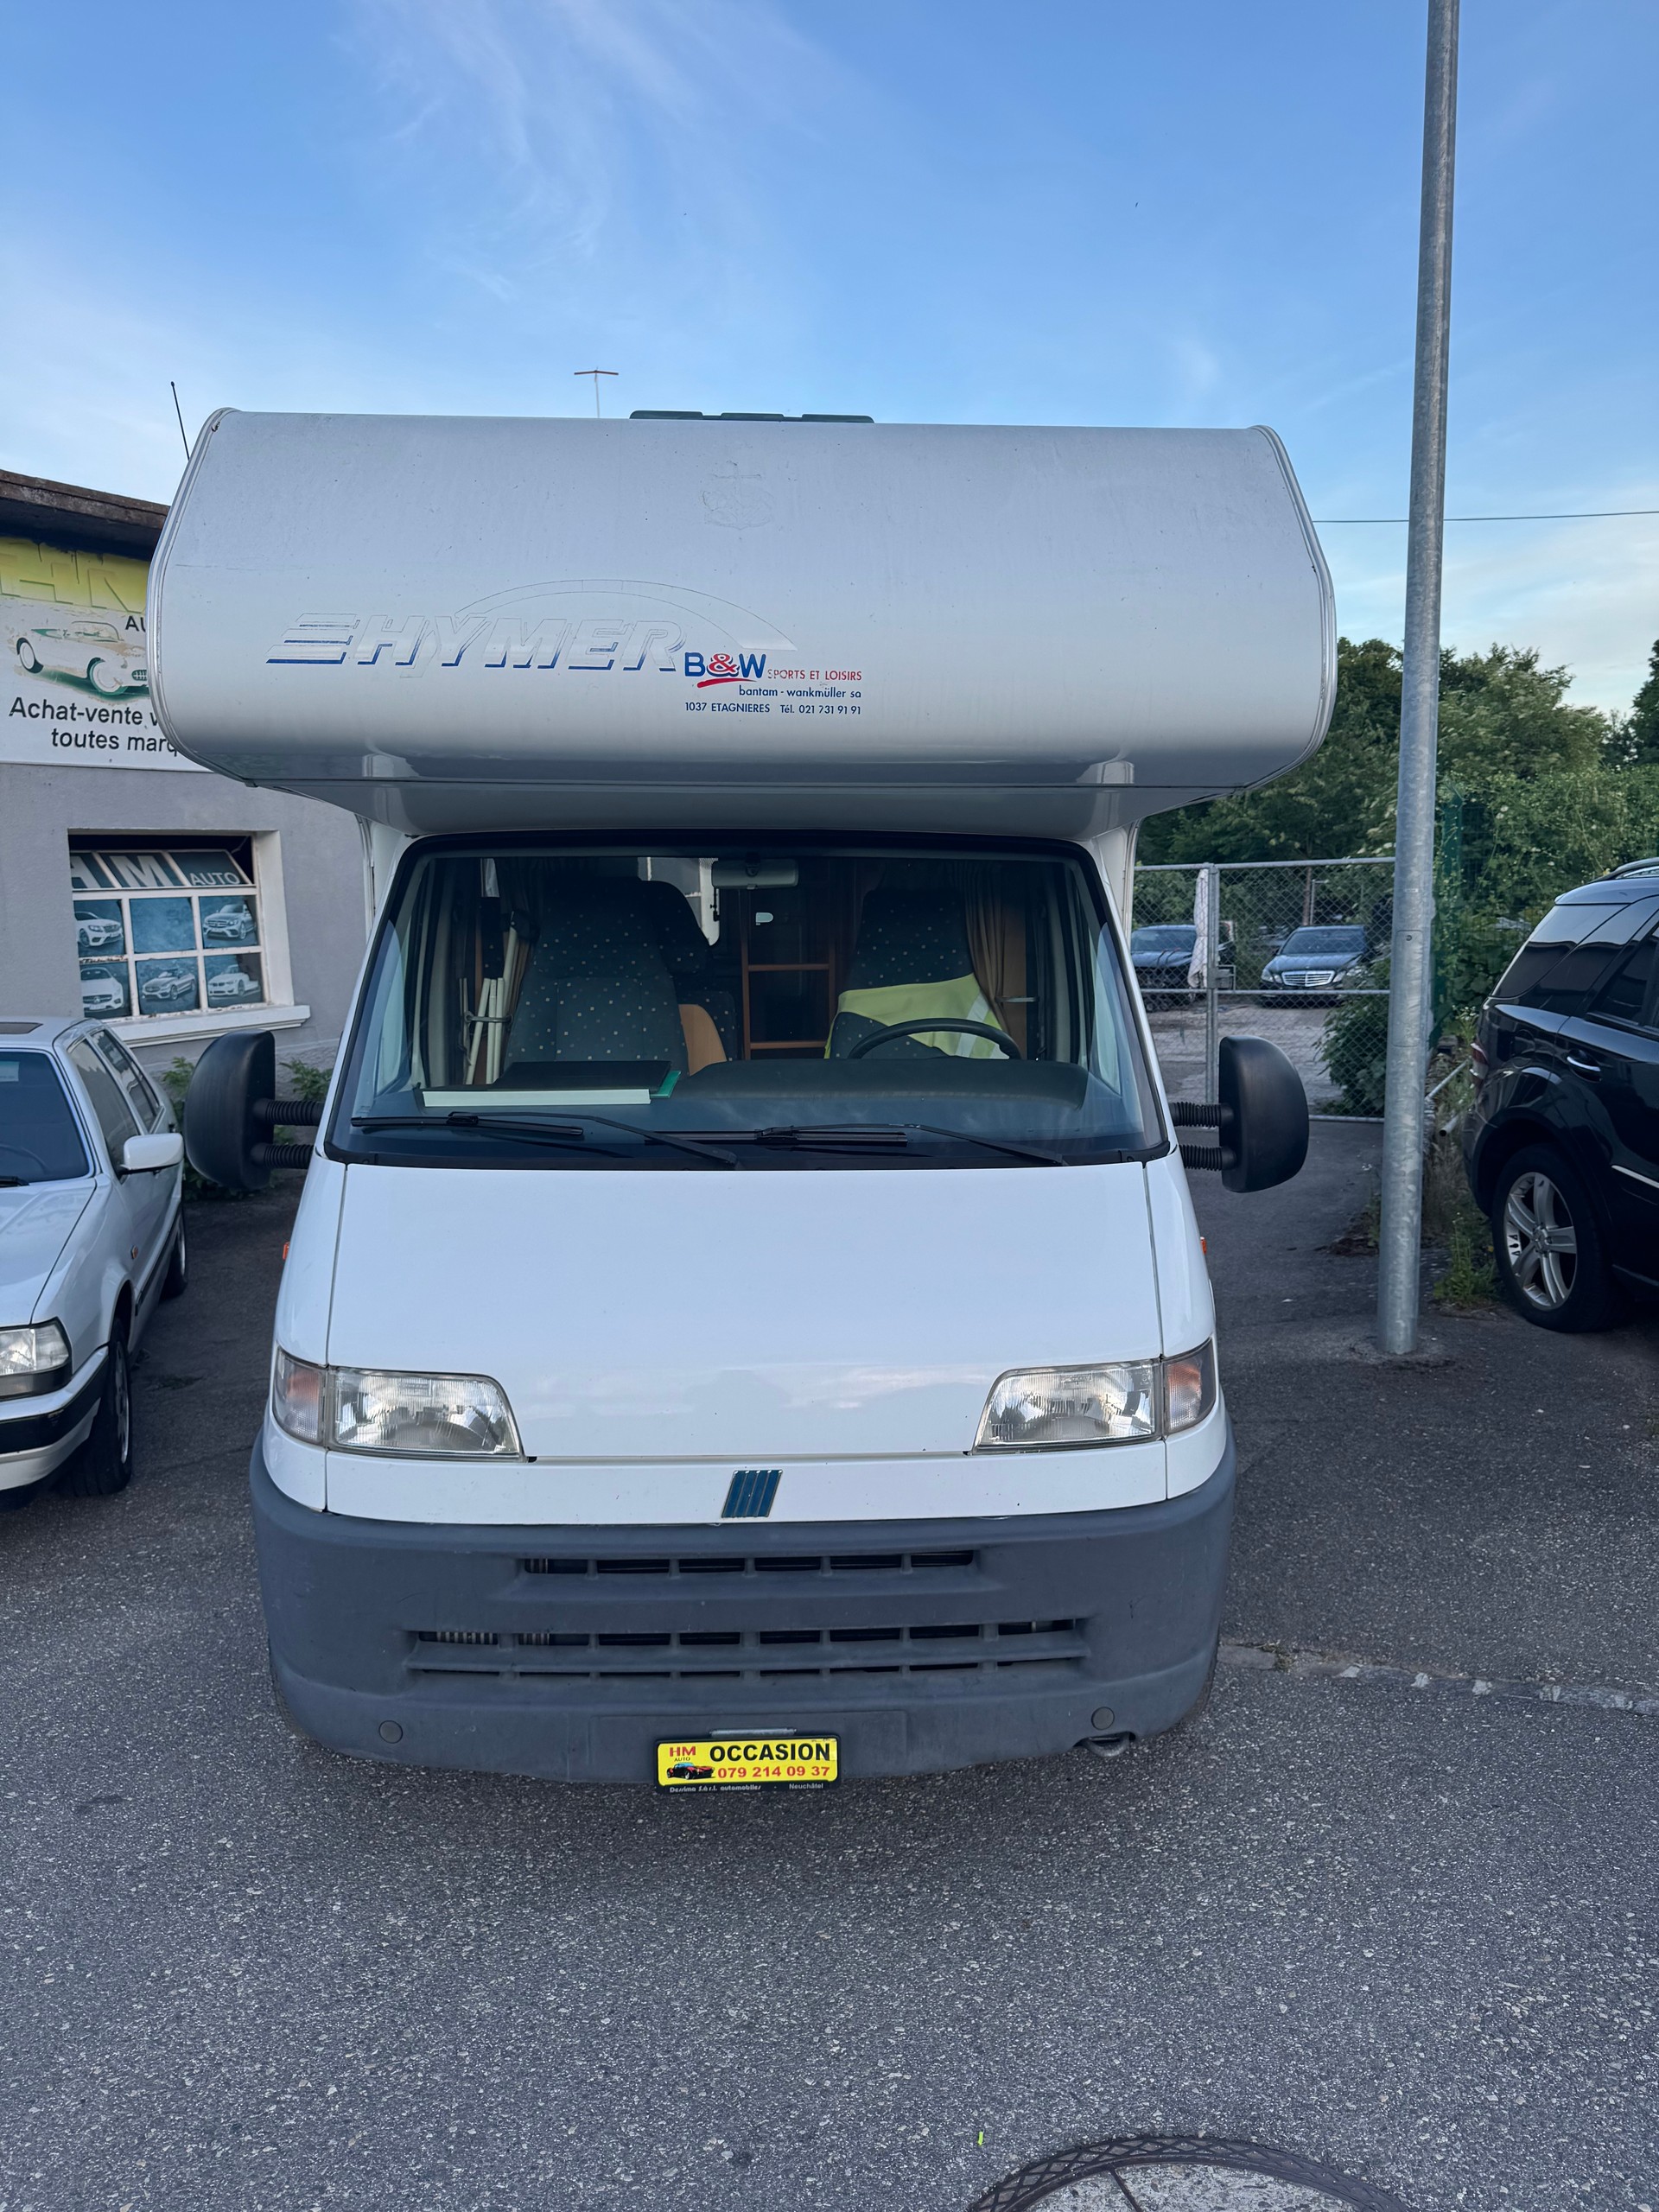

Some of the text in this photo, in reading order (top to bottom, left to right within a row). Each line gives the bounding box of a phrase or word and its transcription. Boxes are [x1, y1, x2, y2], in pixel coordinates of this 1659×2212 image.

[353, 613, 687, 672] HYMER
[684, 652, 862, 681] B&W SPORTS ET LOISIRS
[739, 684, 778, 696] bantam
[786, 686, 847, 698] wankmüller
[9, 696, 143, 725] Achat-vente
[684, 702, 861, 715] 1037 ETAGNIERES Tél. 021 731 91 91
[51, 728, 119, 750] toutes
[189, 872, 241, 887] AUTO
[669, 1743, 830, 1762] HM OCCASION
[717, 1765, 830, 1778] 079 214 09 37
